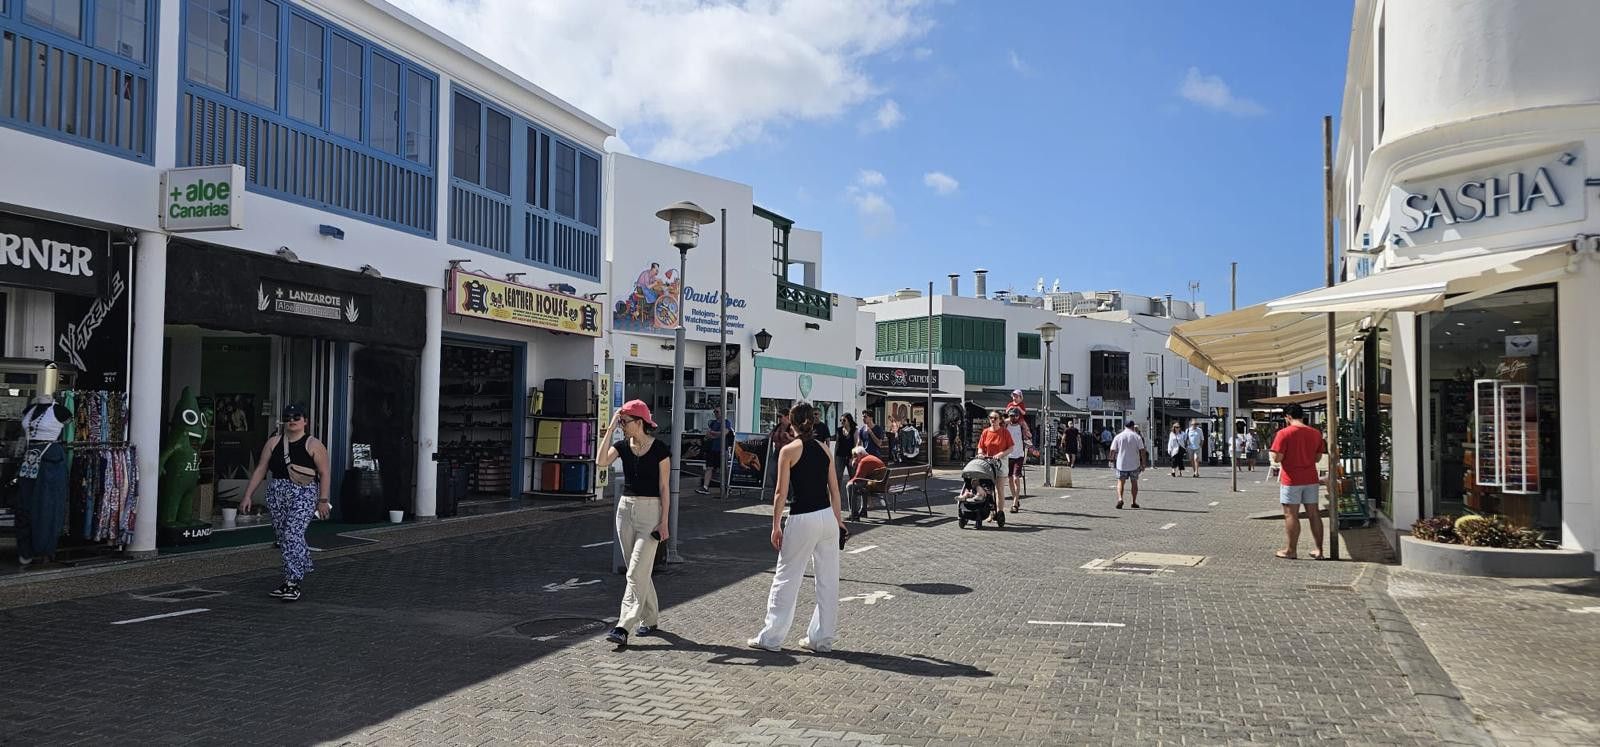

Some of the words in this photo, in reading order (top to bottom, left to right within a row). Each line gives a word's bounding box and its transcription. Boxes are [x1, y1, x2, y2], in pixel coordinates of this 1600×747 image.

[186, 179, 230, 202] aloe
[1401, 166, 1564, 233] SASHA
[169, 202, 230, 218] Canarias
[289, 289, 341, 306] LANZAROTE
[504, 286, 534, 313] LEATHER
[536, 293, 568, 318] HOUSE
[683, 286, 719, 304] David
[684, 315, 720, 326] Watchmaker
[695, 324, 734, 336] Reparacies
[868, 372, 890, 381] JACK'S
[908, 374, 937, 384] CANDIS
